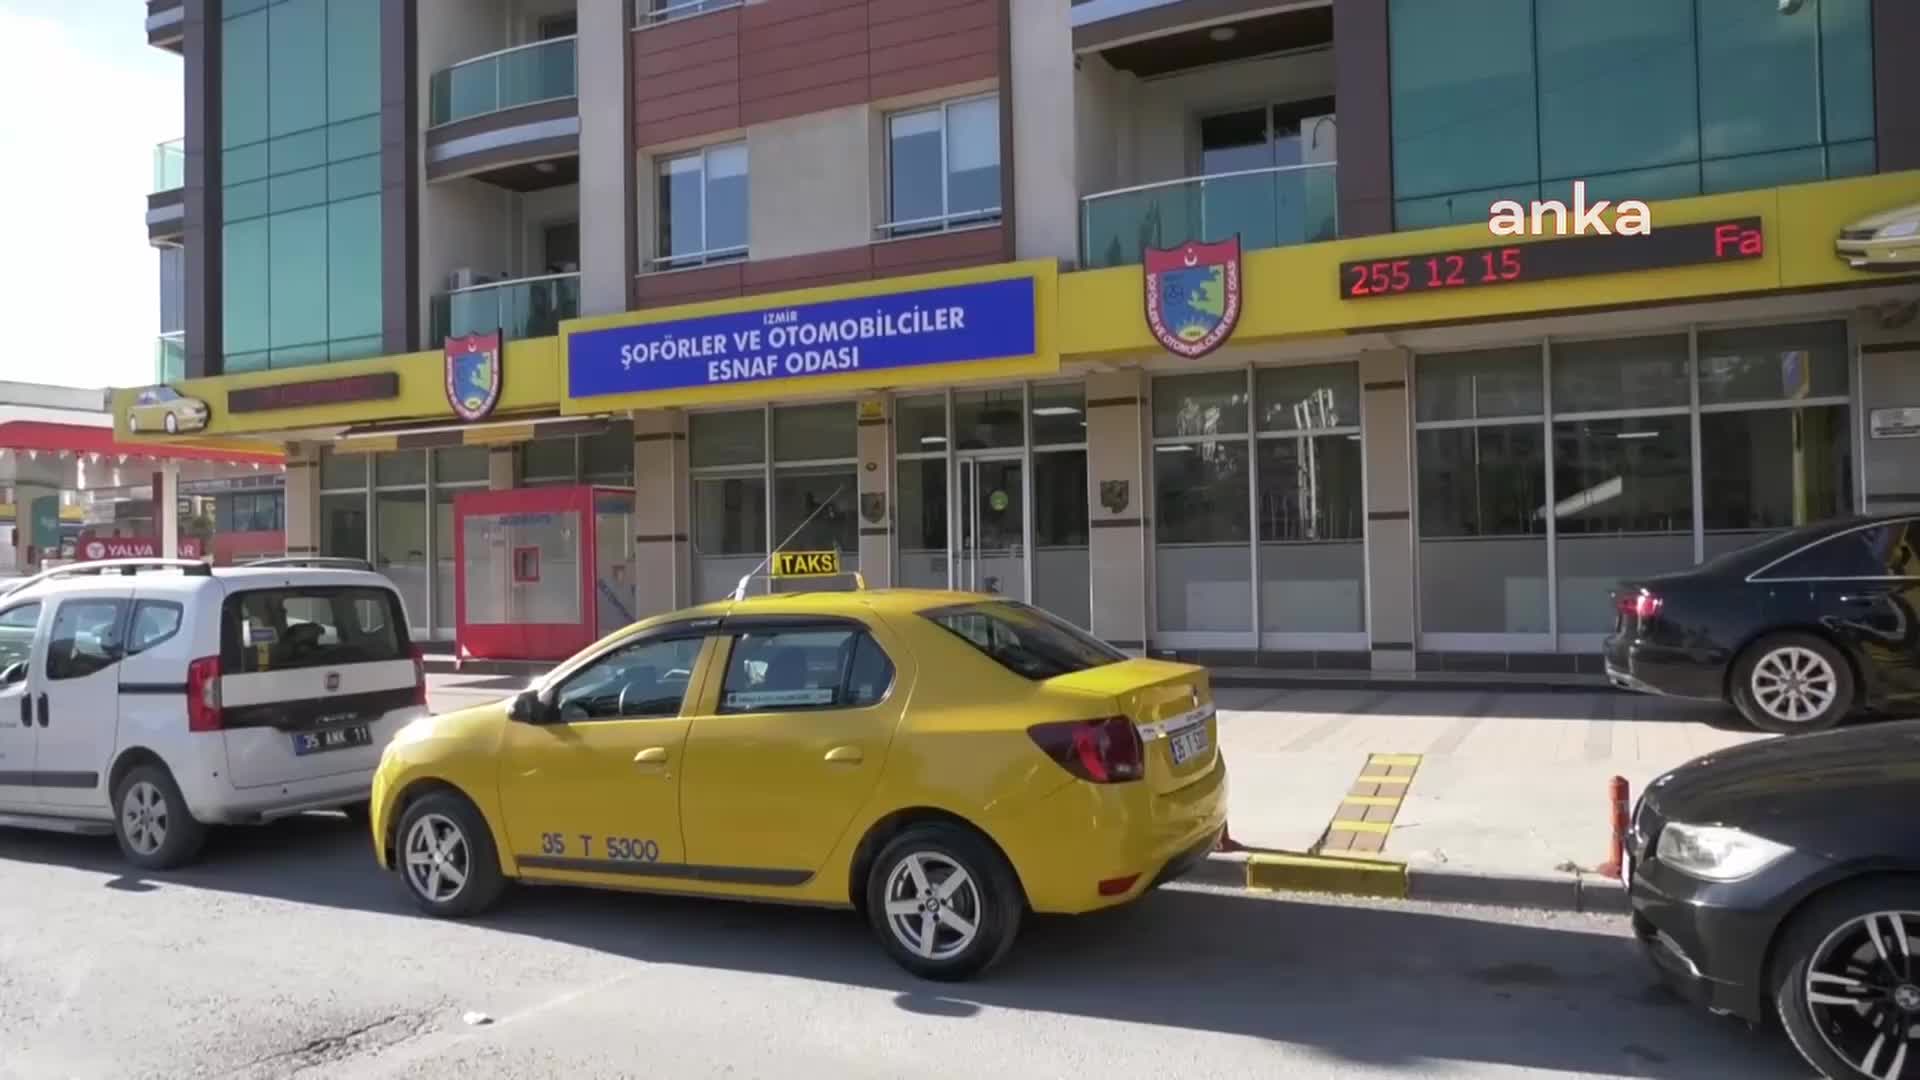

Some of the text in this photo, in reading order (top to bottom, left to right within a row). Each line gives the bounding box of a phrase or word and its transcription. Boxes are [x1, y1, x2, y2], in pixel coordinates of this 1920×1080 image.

[1351, 224, 1763, 295] 255 12 15 Fa
[621, 305, 965, 370] ŞOFÖRLER VE OTOMOBİLCİLER
[708, 346, 859, 381] ESNAF ODASI
[108, 543, 154, 557] YALVA
[541, 832, 659, 862] 35 T 5300
